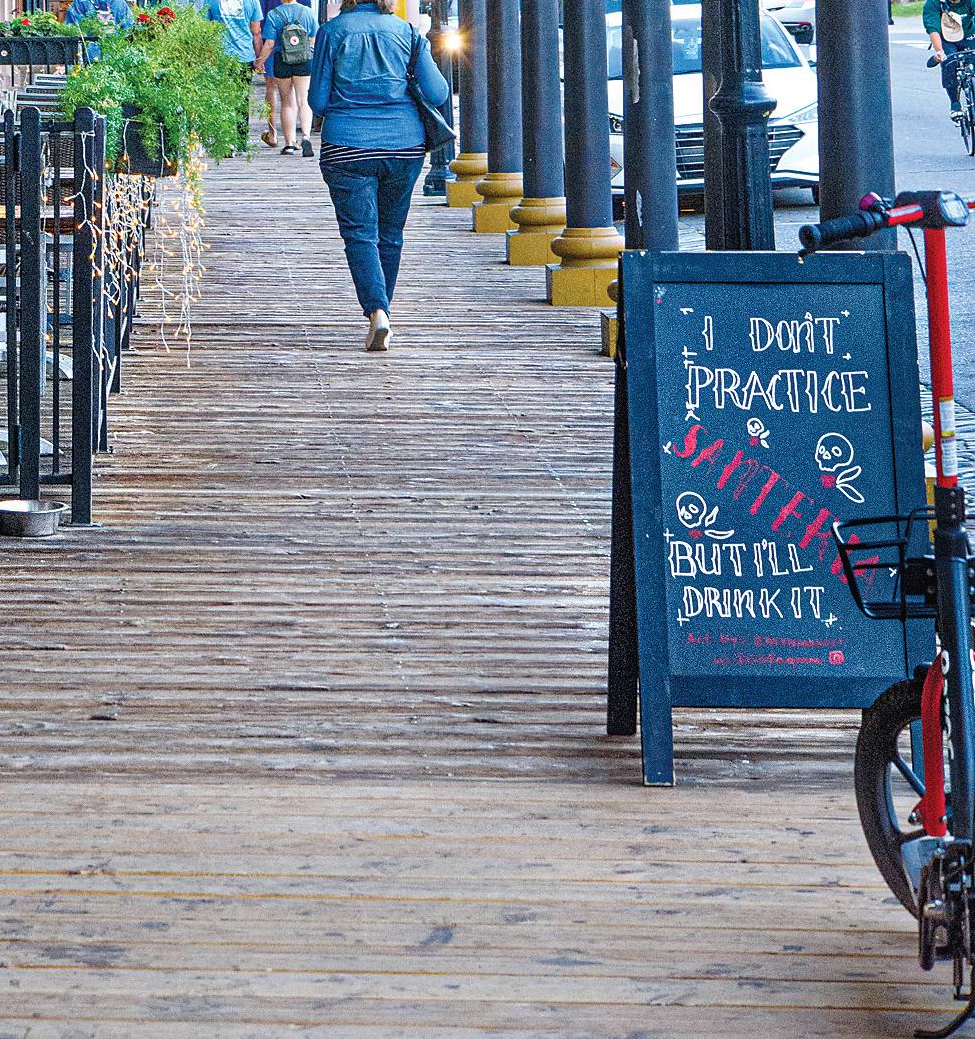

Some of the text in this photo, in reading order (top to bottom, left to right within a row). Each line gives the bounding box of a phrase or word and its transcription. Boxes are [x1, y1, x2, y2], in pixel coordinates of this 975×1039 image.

[702, 315, 714, 351] I
[684, 364, 872, 414] PRACTICE
[667, 540, 747, 579] BUT
[790, 586, 825, 619] IT
